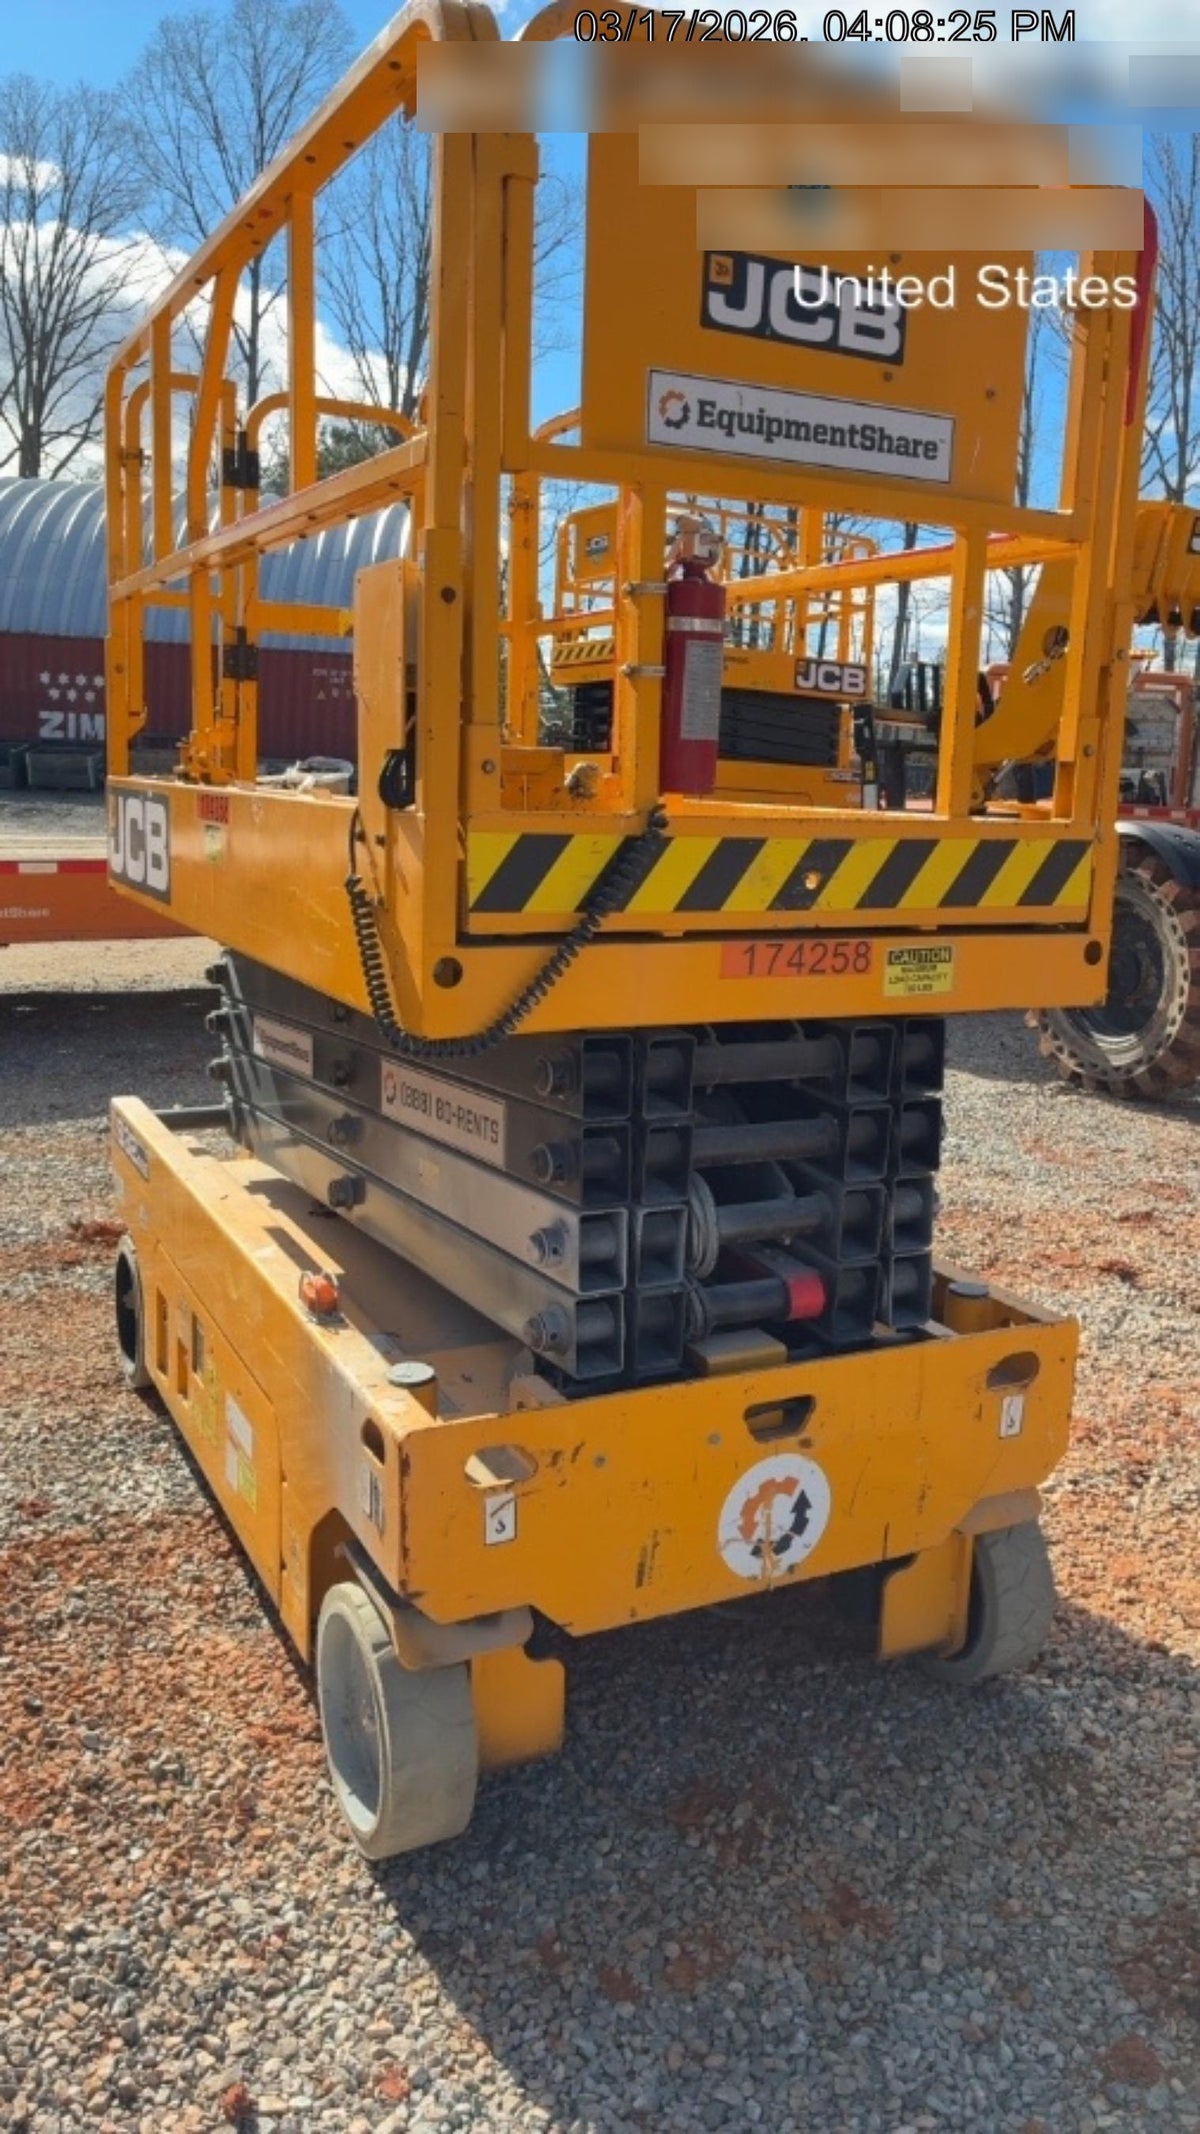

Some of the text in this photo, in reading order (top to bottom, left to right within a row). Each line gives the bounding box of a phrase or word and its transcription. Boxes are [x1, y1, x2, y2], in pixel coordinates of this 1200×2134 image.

[708, 261, 900, 357] JCB
[696, 399, 940, 460] EquipmentShare
[796, 662, 865, 694] JCB
[38, 711, 105, 740] ZIM
[111, 796, 169, 891] JCB
[743, 941, 871, 976] 174258
[891, 948, 950, 964] CAUTION
